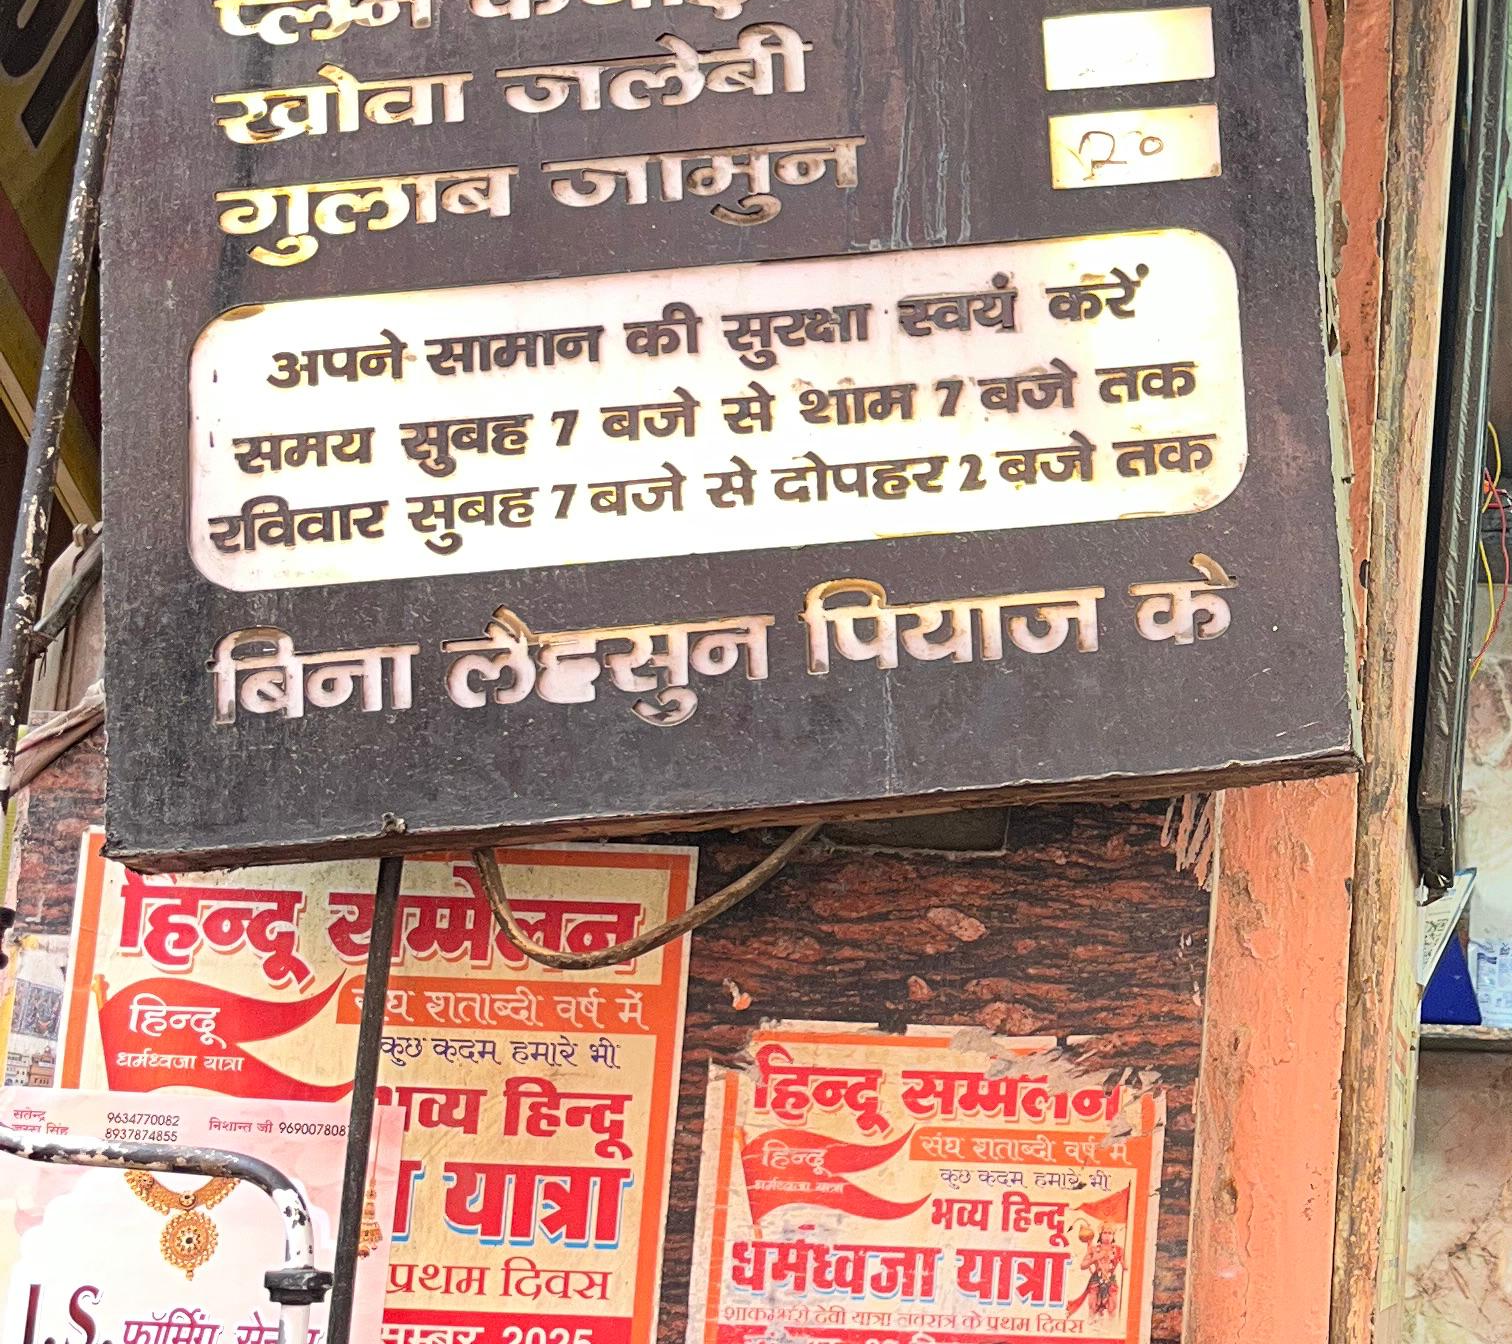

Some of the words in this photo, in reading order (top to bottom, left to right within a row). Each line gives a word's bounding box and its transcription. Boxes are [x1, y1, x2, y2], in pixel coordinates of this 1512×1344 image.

[216, 66, 474, 146] खोवा
[493, 24, 814, 113] जलेबी
[216, 166, 519, 267] गुलाब
[540, 136, 867, 226] जामुन
[268, 328, 416, 389] अपने
[425, 321, 606, 376] सामान
[625, 301, 701, 363] की
[721, 301, 872, 373] सुरक्षा
[896, 270, 1018, 340] स्वयं
[1044, 265, 1150, 325] करें
[231, 425, 375, 476] समय
[399, 411, 531, 488] सुबह
[553, 408, 578, 447] 7
[600, 381, 698, 442] बजे
[721, 381, 782, 434] से
[798, 376, 917, 427] शाम
[937, 380, 964, 419] 7
[978, 358, 1076, 414] बजे
[1096, 358, 1200, 407] तक
[207, 496, 390, 556] रविवार
[405, 489, 535, 564] सुबह
[552, 481, 576, 520] 7
[589, 463, 692, 518] बजे
[703, 455, 759, 510] से
[770, 453, 947, 504] दोपहर
[955, 456, 987, 495] 2
[993, 432, 1099, 488] बजे
[1110, 431, 1216, 481] तक
[209, 626, 419, 724] बिना
[800, 577, 1107, 679] पियाज
[1127, 554, 1237, 648] के
[128, 992, 227, 1049] हिन्दू
[424, 985, 544, 1027] शताब्दी
[615, 987, 650, 1031] में
[431, 1037, 502, 1066] कदम
[510, 1034, 578, 1068] हमारे
[107, 1111, 181, 1128] 9634770082
[503, 1076, 633, 1161] हिन्दू
[754, 1044, 891, 1134] हिन्दू
[761, 1139, 833, 1178] हिन्दू
[977, 1169, 1028, 1189] कदम
[443, 1161, 634, 1249] यात्रा
[930, 1197, 993, 1231] भव्य
[1001, 1190, 1070, 1248] हिन्दू
[386, 1263, 491, 1296] प्रथम
[500, 1256, 614, 1301] दिवस
[955, 1248, 1072, 1308] यात्रा
